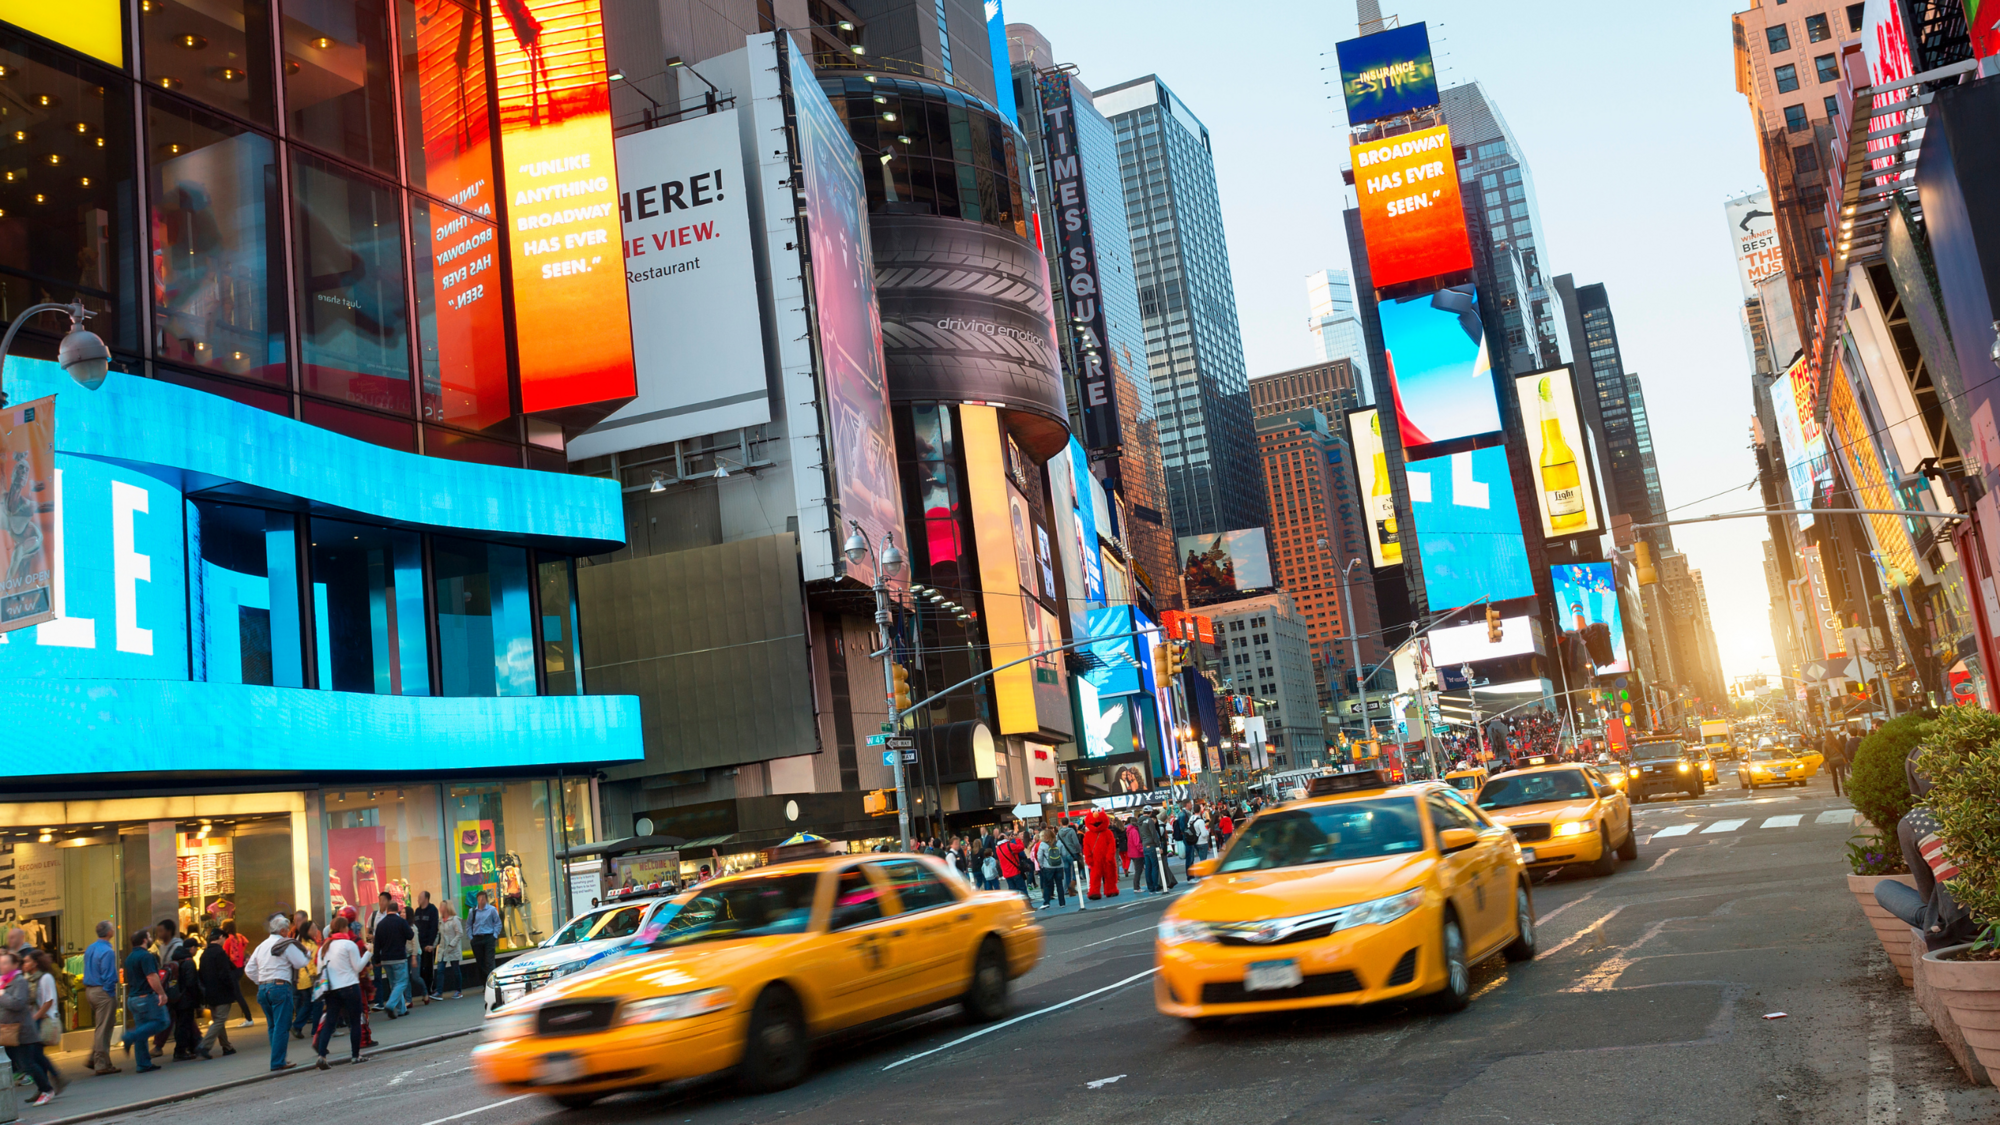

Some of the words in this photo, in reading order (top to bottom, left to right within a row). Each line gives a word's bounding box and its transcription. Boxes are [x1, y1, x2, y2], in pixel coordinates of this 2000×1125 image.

[1360, 60, 1416, 83] INSURANCE
[1358, 133, 1446, 168] BROADWAY
[518, 153, 591, 178] "UNLIKE
[1046, 105, 1083, 232] TIMES
[1366, 172, 1402, 195] HAS
[1405, 161, 1445, 184] EVER
[514, 176, 609, 207] ANYTHING
[1386, 189, 1441, 217] SEEN."
[516, 202, 613, 232] BROADWAY
[523, 236, 561, 256] HAS
[564, 229, 608, 250] EVER
[651, 220, 721, 251] VIEW.
[1740, 228, 1773, 243] WINNER
[1742, 235, 1774, 254] BEST
[541, 256, 602, 280] SEEN."
[627, 257, 701, 284] Restaurant
[937, 317, 995, 335] driving
[997, 326, 1045, 348] emotion
[1069, 246, 1108, 407] SQUARE
[1789, 360, 1810, 393] THE
[1798, 401, 1814, 426] GOE
[37, 468, 154, 656] LE
[0, 577, 22, 591] NOW
[24, 569, 51, 585] OPEN
[866, 736, 874, 745] W
[875, 735, 885, 745] 45
[19, 861, 43, 872] SECOND
[43, 858, 62, 868] LEVEL
[638, 860, 667, 872] WELCOME
[604, 945, 623, 957] POLICE
